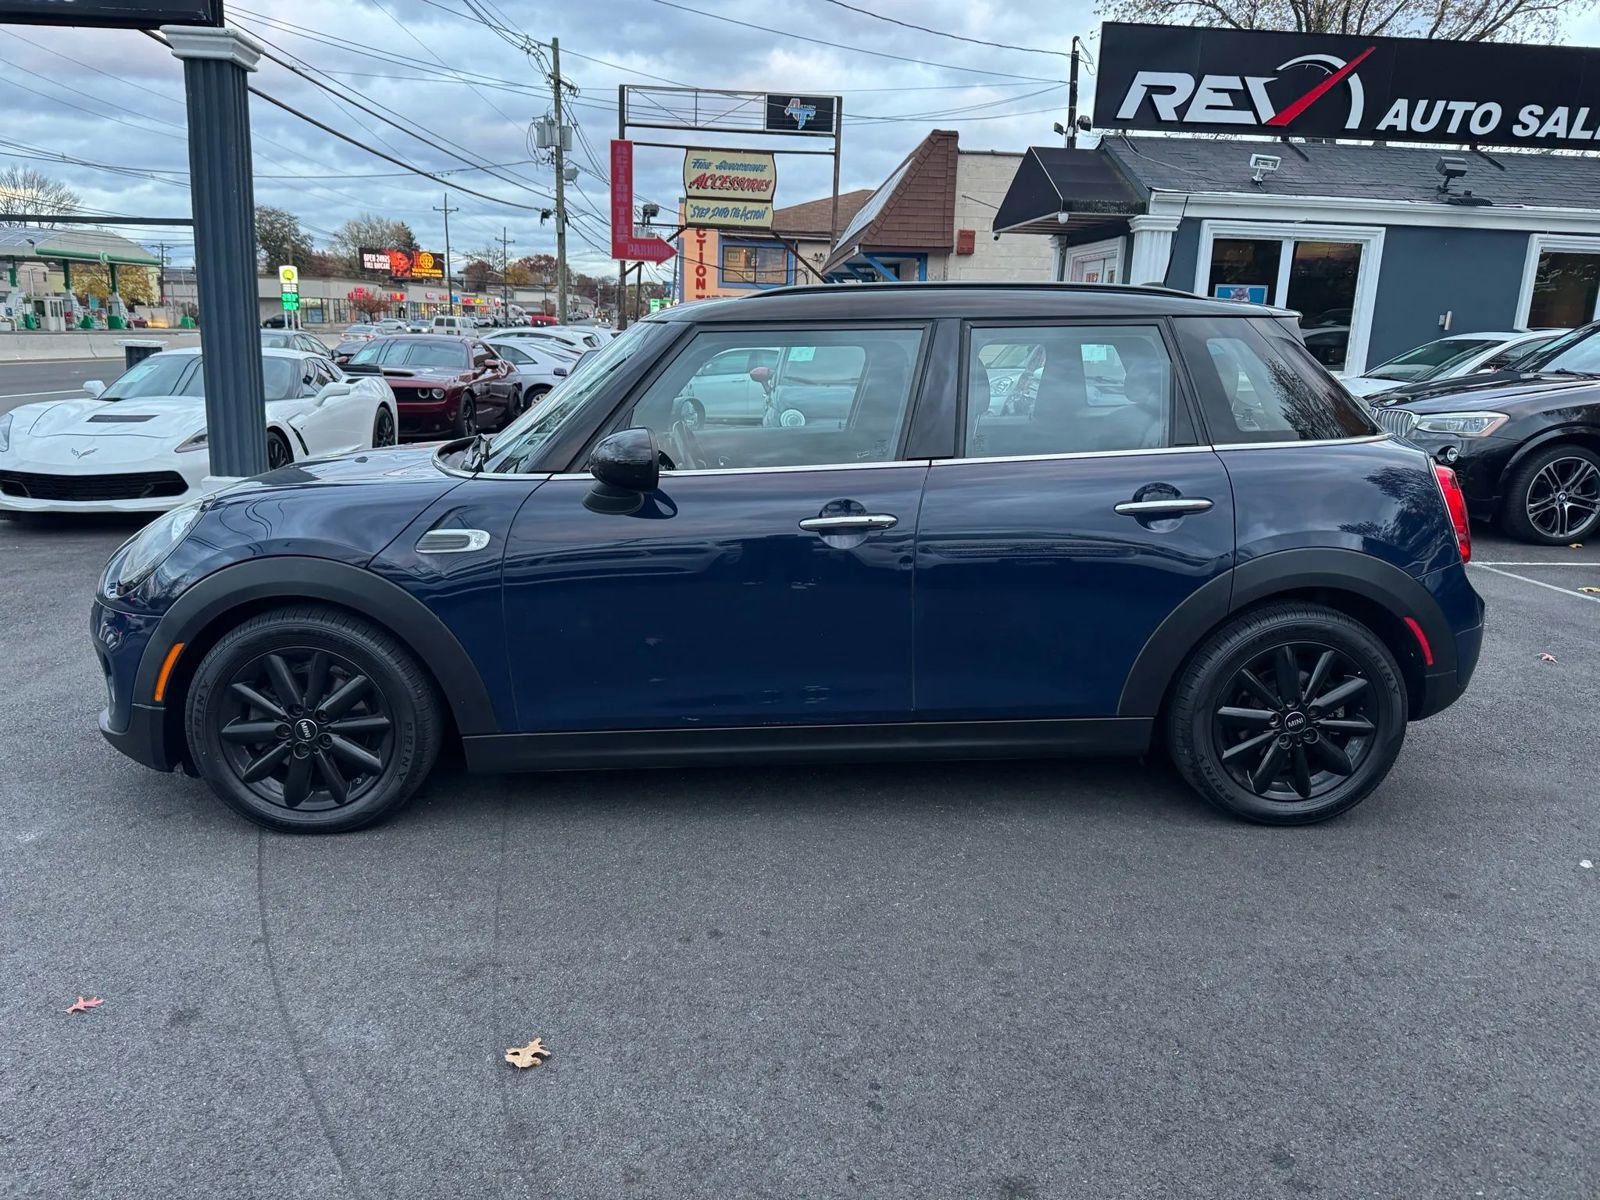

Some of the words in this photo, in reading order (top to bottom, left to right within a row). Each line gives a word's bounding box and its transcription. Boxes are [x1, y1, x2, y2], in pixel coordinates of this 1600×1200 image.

[1375, 98, 1503, 136] AUTO
[1512, 104, 1600, 141] SAL
[688, 172, 772, 193] ACCESSORIES
[300, 721, 311, 738] MINI
[1287, 716, 1304, 728] MINI
